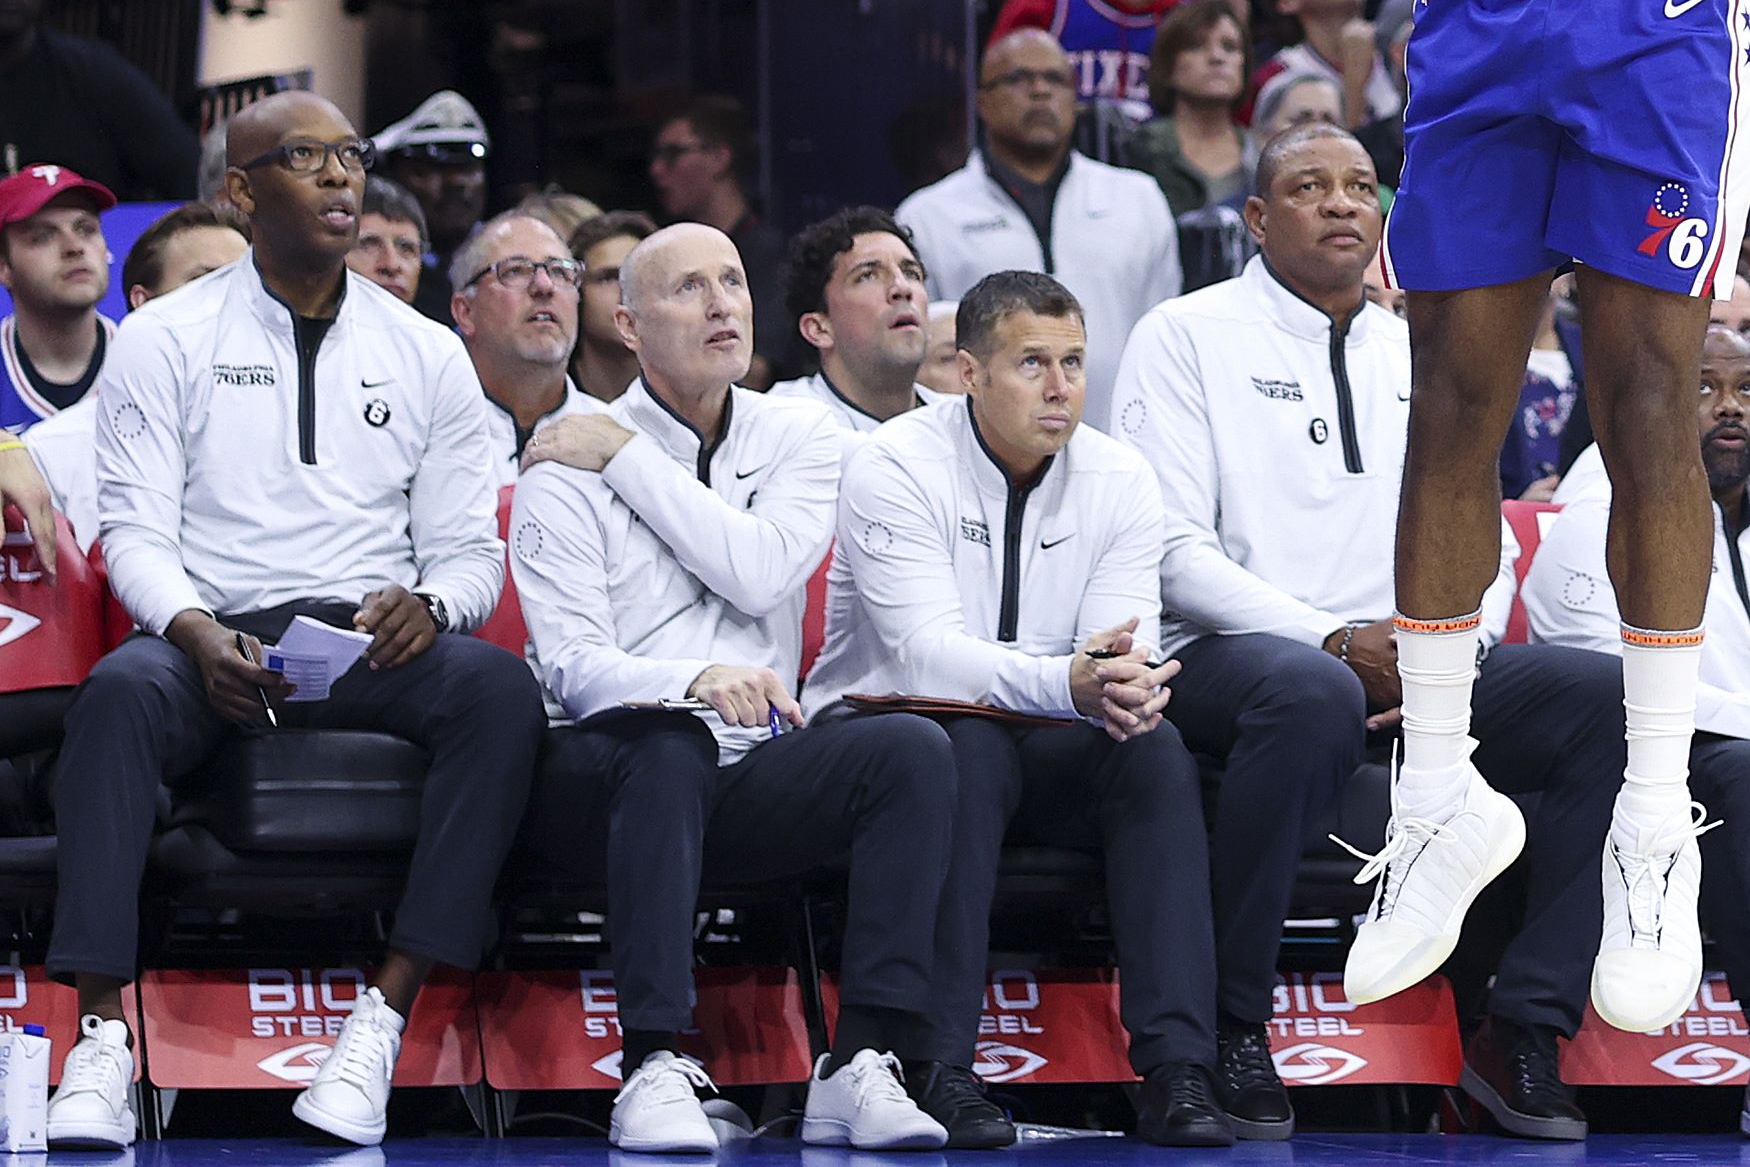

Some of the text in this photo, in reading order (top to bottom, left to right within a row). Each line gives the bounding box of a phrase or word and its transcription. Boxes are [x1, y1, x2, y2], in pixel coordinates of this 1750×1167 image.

[1636, 192, 1710, 270] 76
[214, 371, 275, 386] 76ERS
[366, 399, 391, 427] 6
[1309, 418, 1328, 445] 6
[248, 968, 368, 1012] BIO
[251, 1016, 347, 1038] STEE
